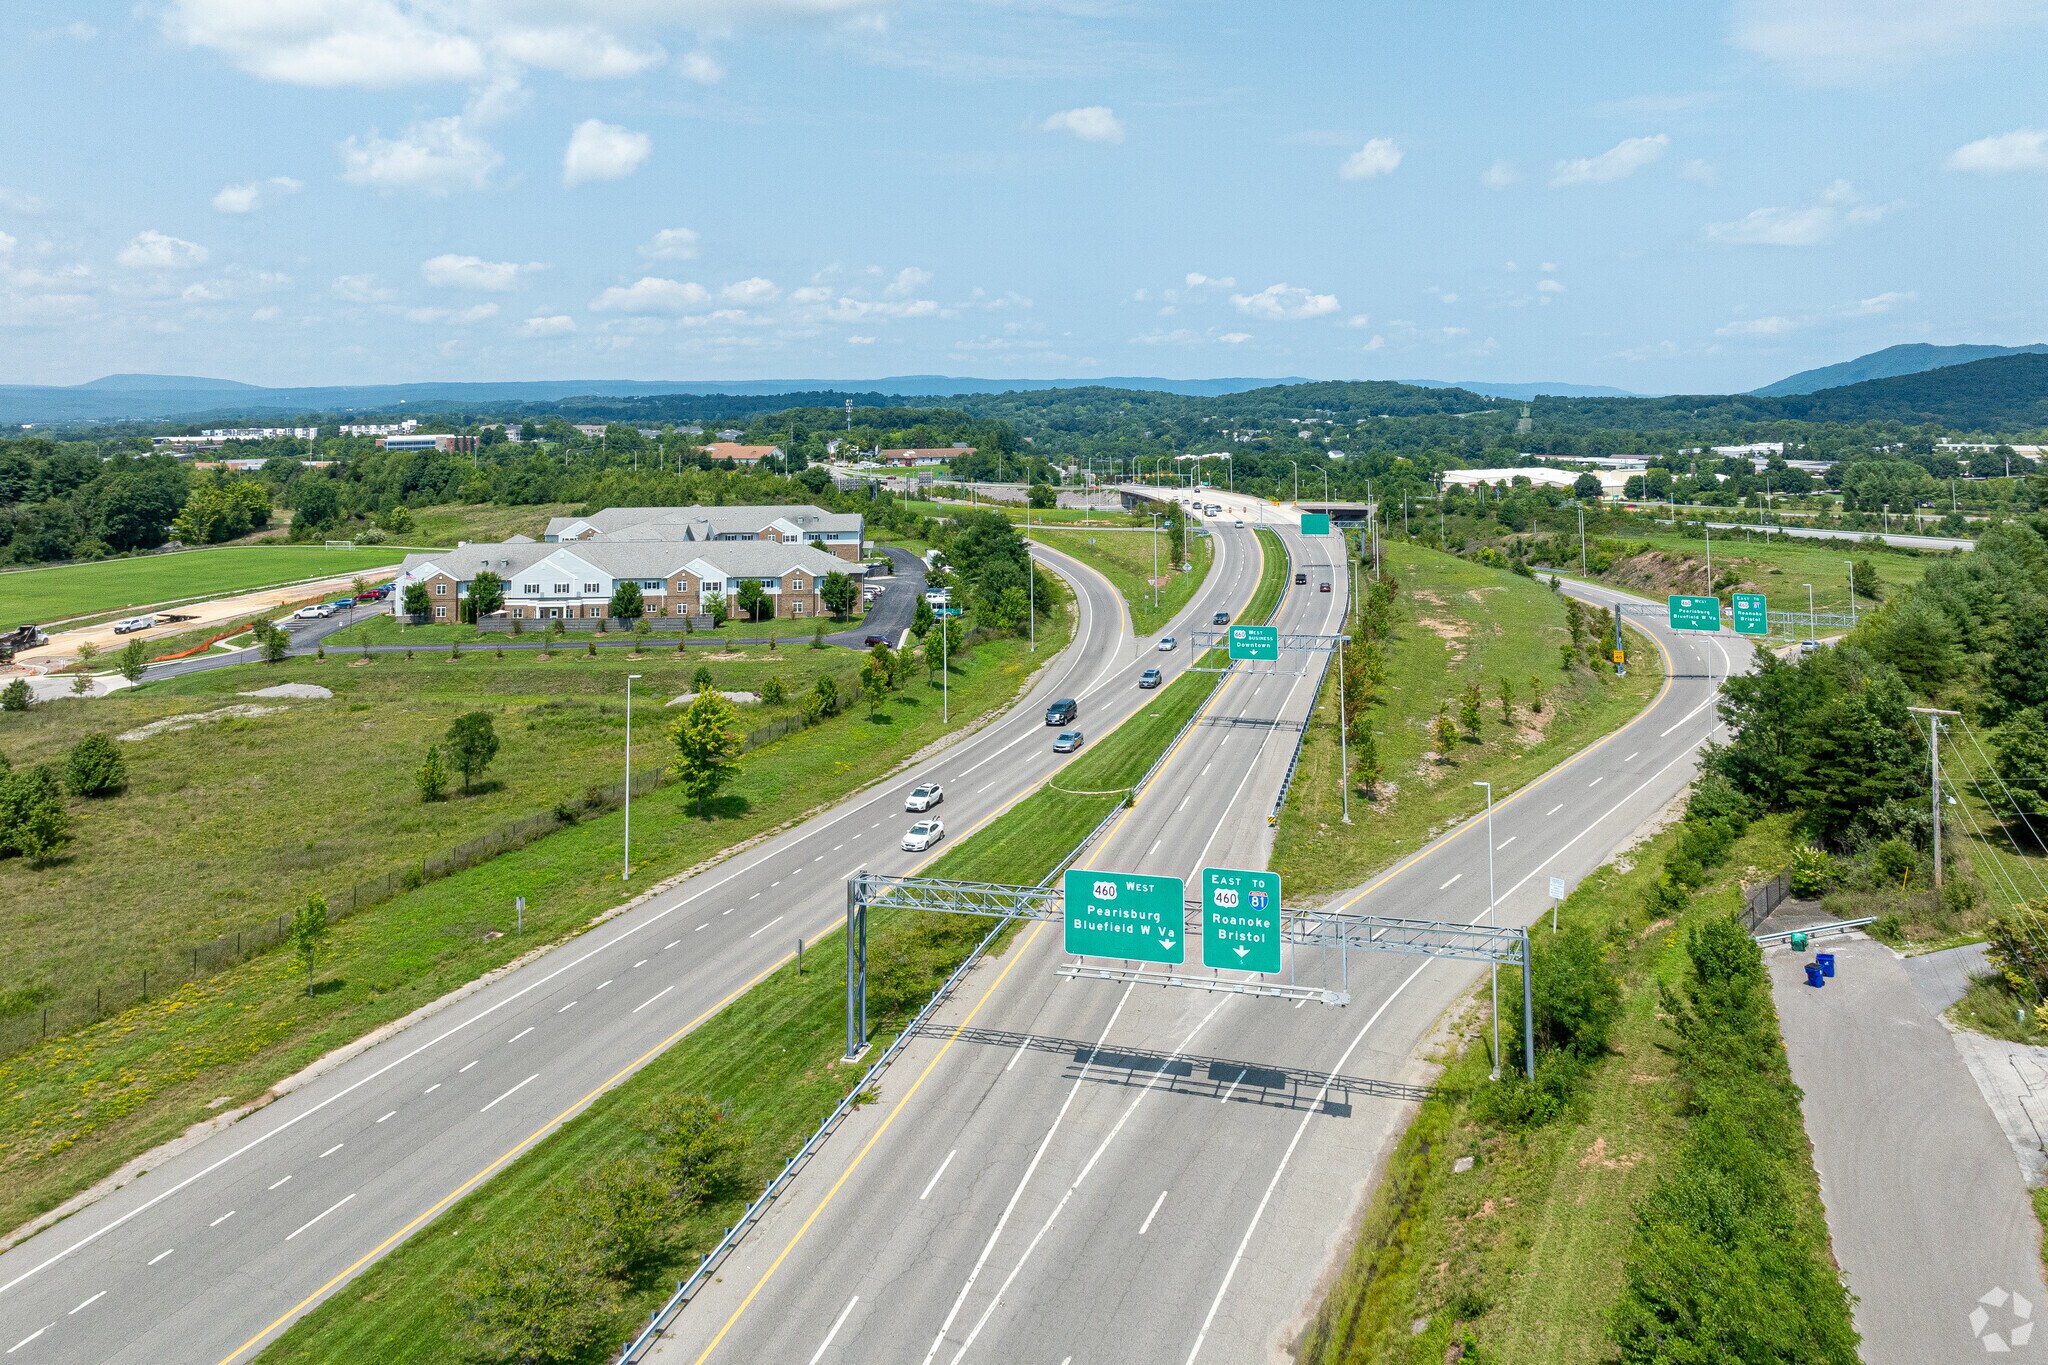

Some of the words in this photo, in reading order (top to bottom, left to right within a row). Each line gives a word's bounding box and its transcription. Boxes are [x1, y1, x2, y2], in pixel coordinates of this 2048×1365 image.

[1125, 881, 1155, 893] WEST
[1211, 874, 1242, 886] EAST
[1252, 879, 1266, 888] TO
[1094, 885, 1116, 897] 460
[1215, 892, 1237, 905] 460
[1251, 896, 1265, 908] 81
[1087, 905, 1161, 924] Pearisburg
[1212, 913, 1271, 928] Roanoke
[1073, 918, 1134, 934] Bluefield
[1140, 924, 1151, 936] W
[1158, 926, 1176, 938] Va
[1218, 928, 1266, 943] Bristol
